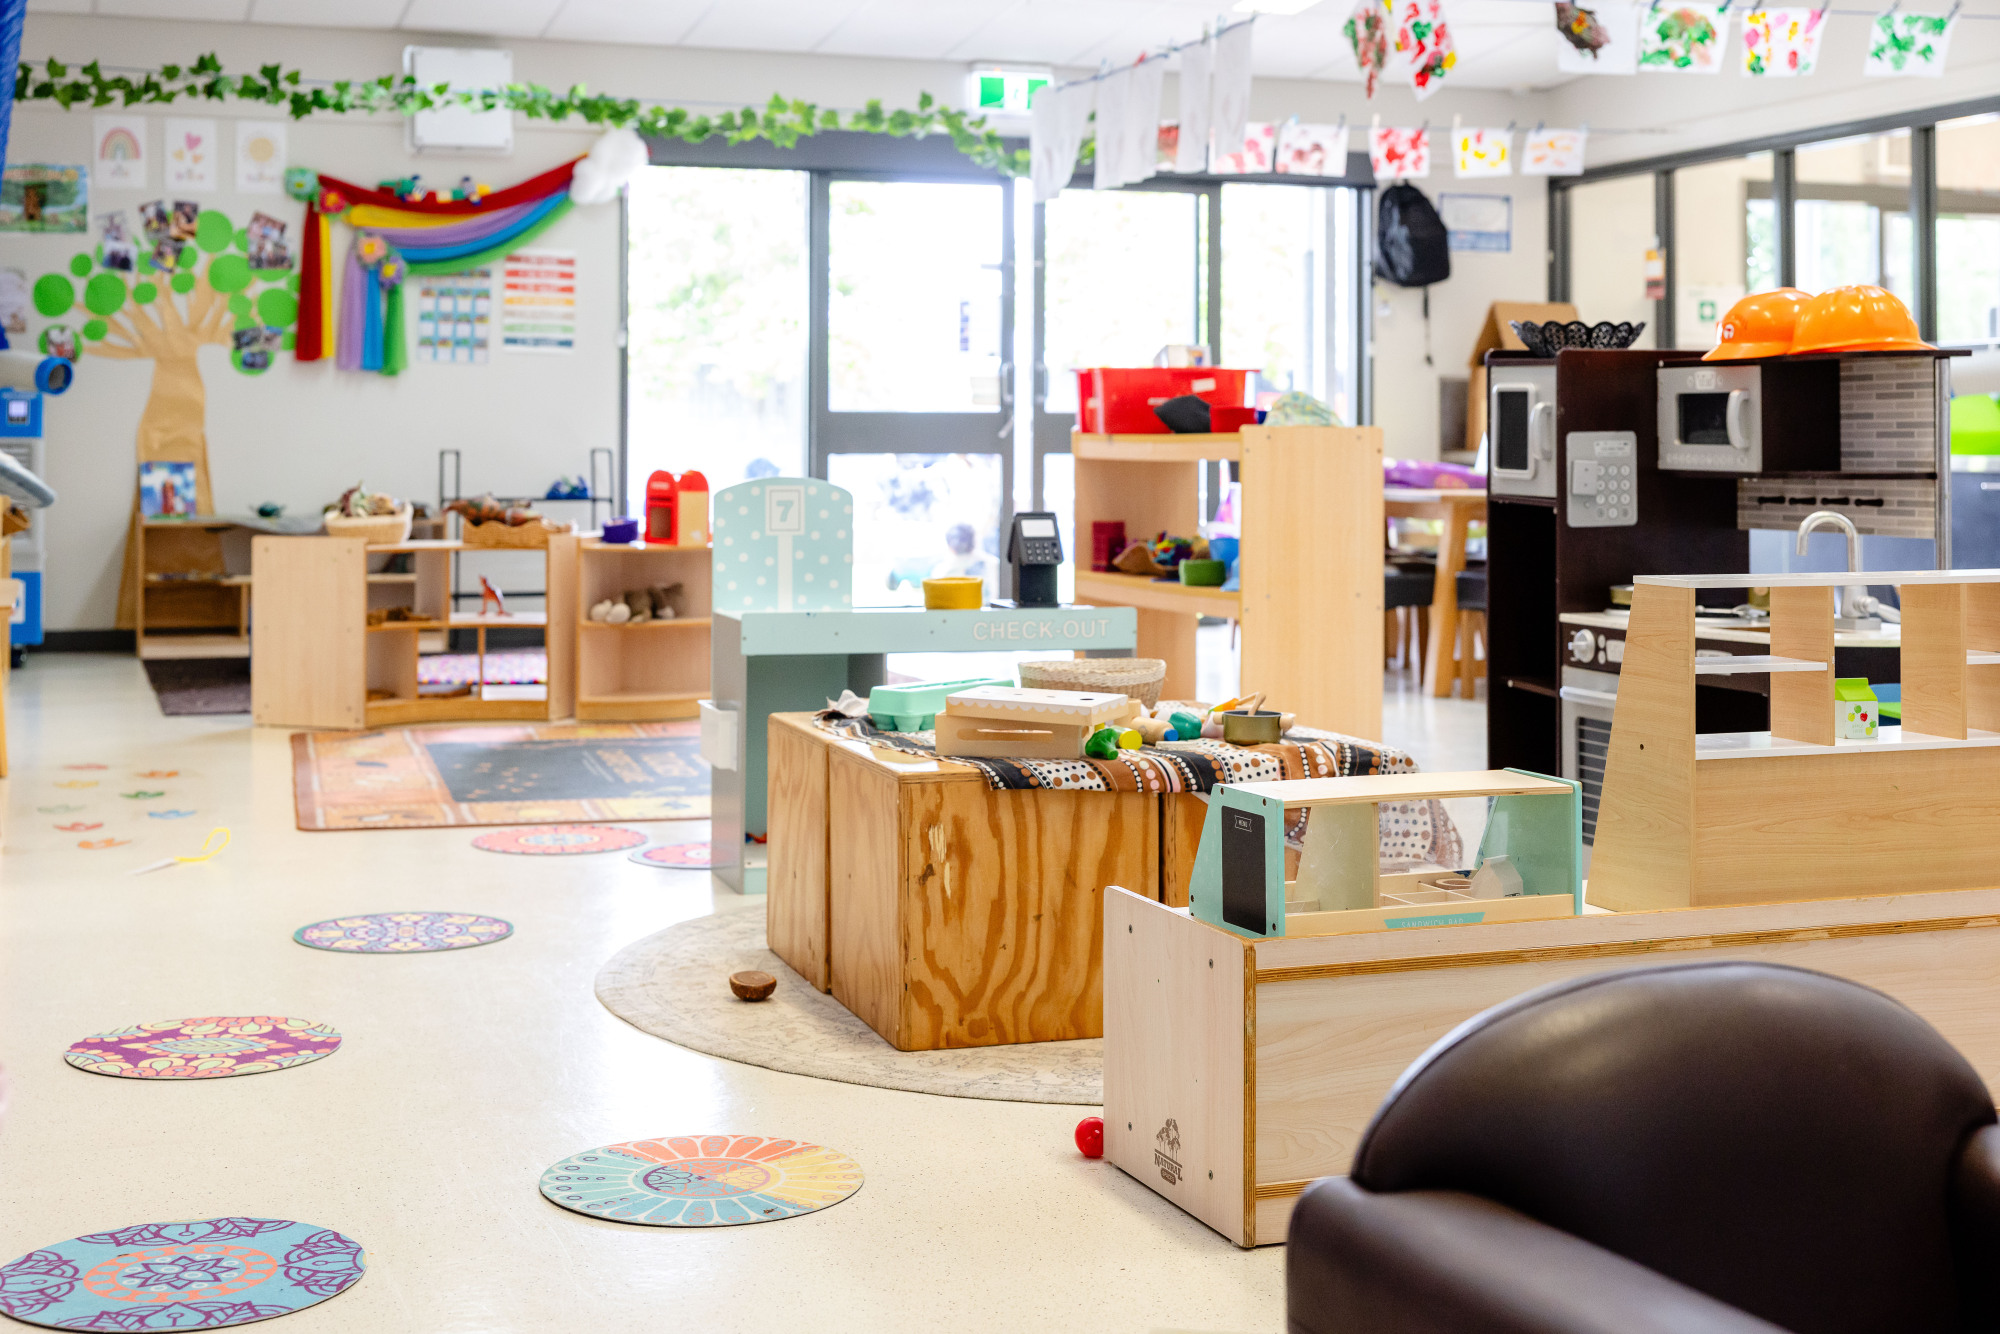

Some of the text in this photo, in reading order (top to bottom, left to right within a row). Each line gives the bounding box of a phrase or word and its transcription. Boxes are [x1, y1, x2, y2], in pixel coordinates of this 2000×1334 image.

[776, 500, 794, 522] 7
[973, 619, 1110, 641] CHECK-OUT
[1154, 1153, 1183, 1181] NATURAL
